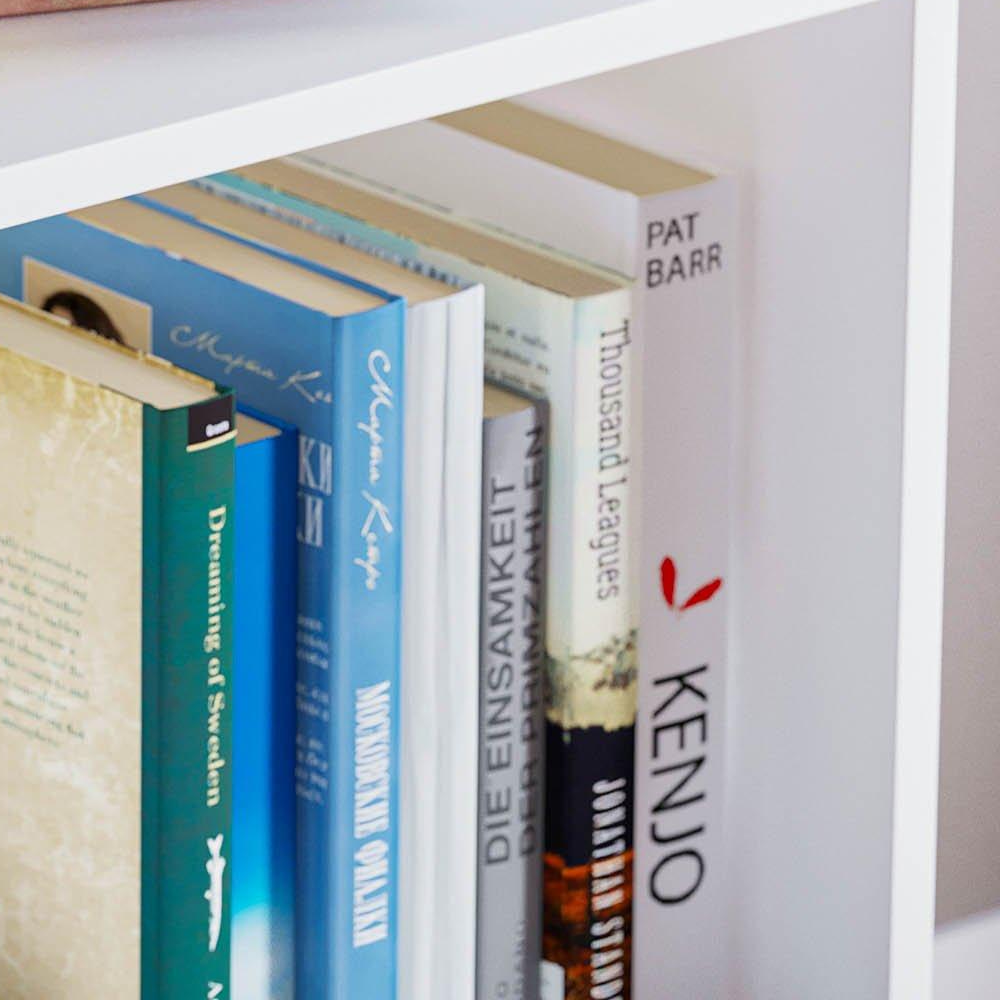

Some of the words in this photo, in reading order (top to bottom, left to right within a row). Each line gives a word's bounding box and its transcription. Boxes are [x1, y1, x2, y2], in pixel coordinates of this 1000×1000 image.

[647, 212, 699, 248] PAT
[647, 243, 722, 288] BARR
[597, 318, 631, 473] Thousand
[204, 505, 227, 652] Dreaming
[589, 477, 628, 602] Leagues
[207, 658, 226, 688] of
[488, 478, 519, 771] EINSAMKEIT
[206, 692, 226, 807] Sweden
[651, 664, 708, 906] KENJO
[487, 784, 512, 865] DIE
[519, 764, 539, 858] DER
[591, 778, 627, 912] JONATHAN
[352, 839, 389, 948] ФИАЛКИ
[590, 916, 626, 1000] STAND
